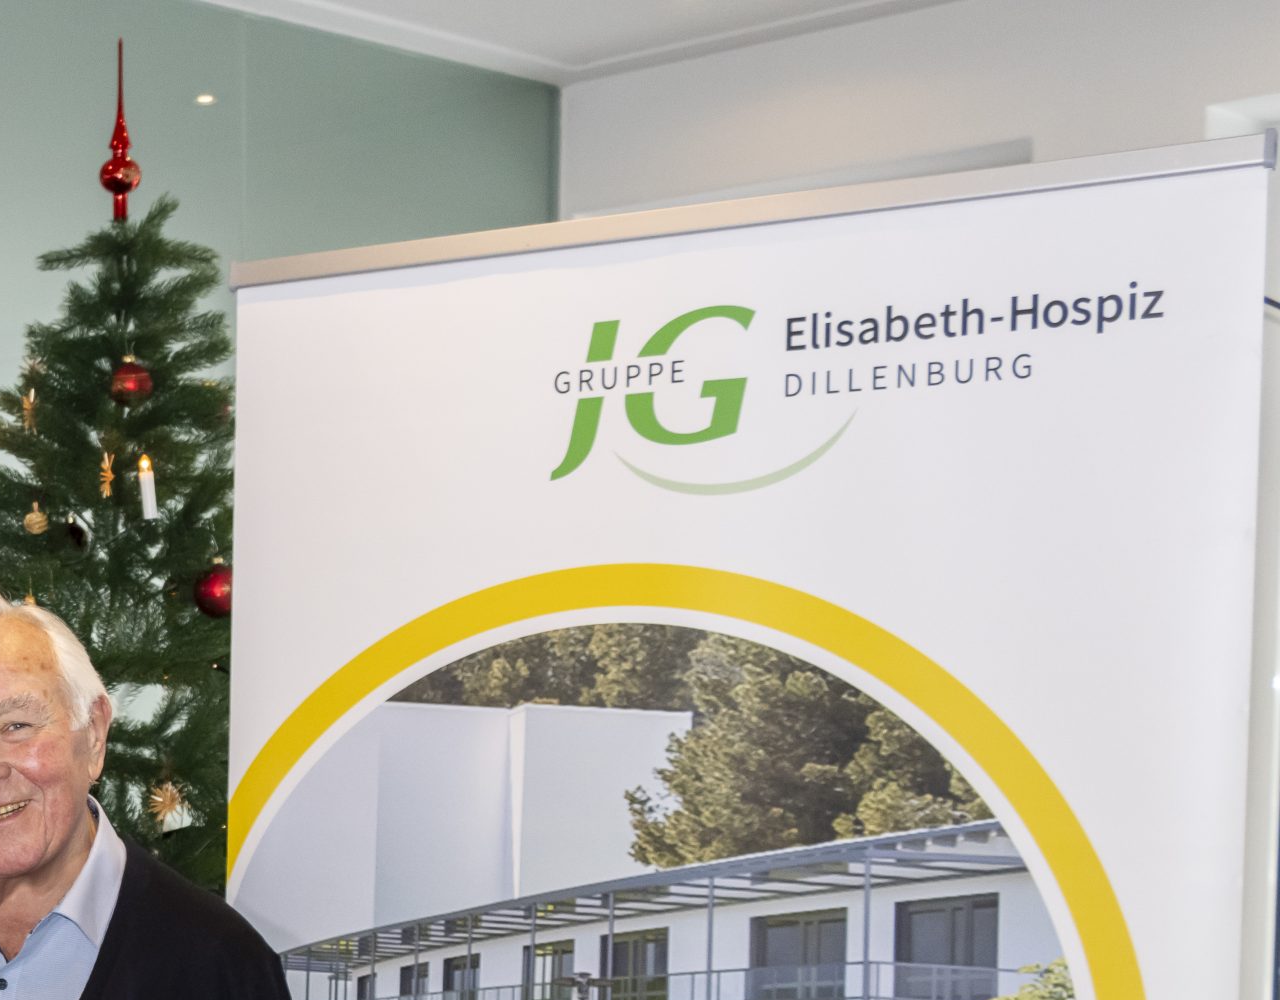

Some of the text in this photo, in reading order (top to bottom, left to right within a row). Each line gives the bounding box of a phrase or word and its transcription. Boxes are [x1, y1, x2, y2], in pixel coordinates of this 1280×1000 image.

[784, 281, 1165, 352] Elisabeth-Hospiz
[554, 360, 686, 395] GRUPPE
[784, 353, 1034, 398] DILLENBURG
